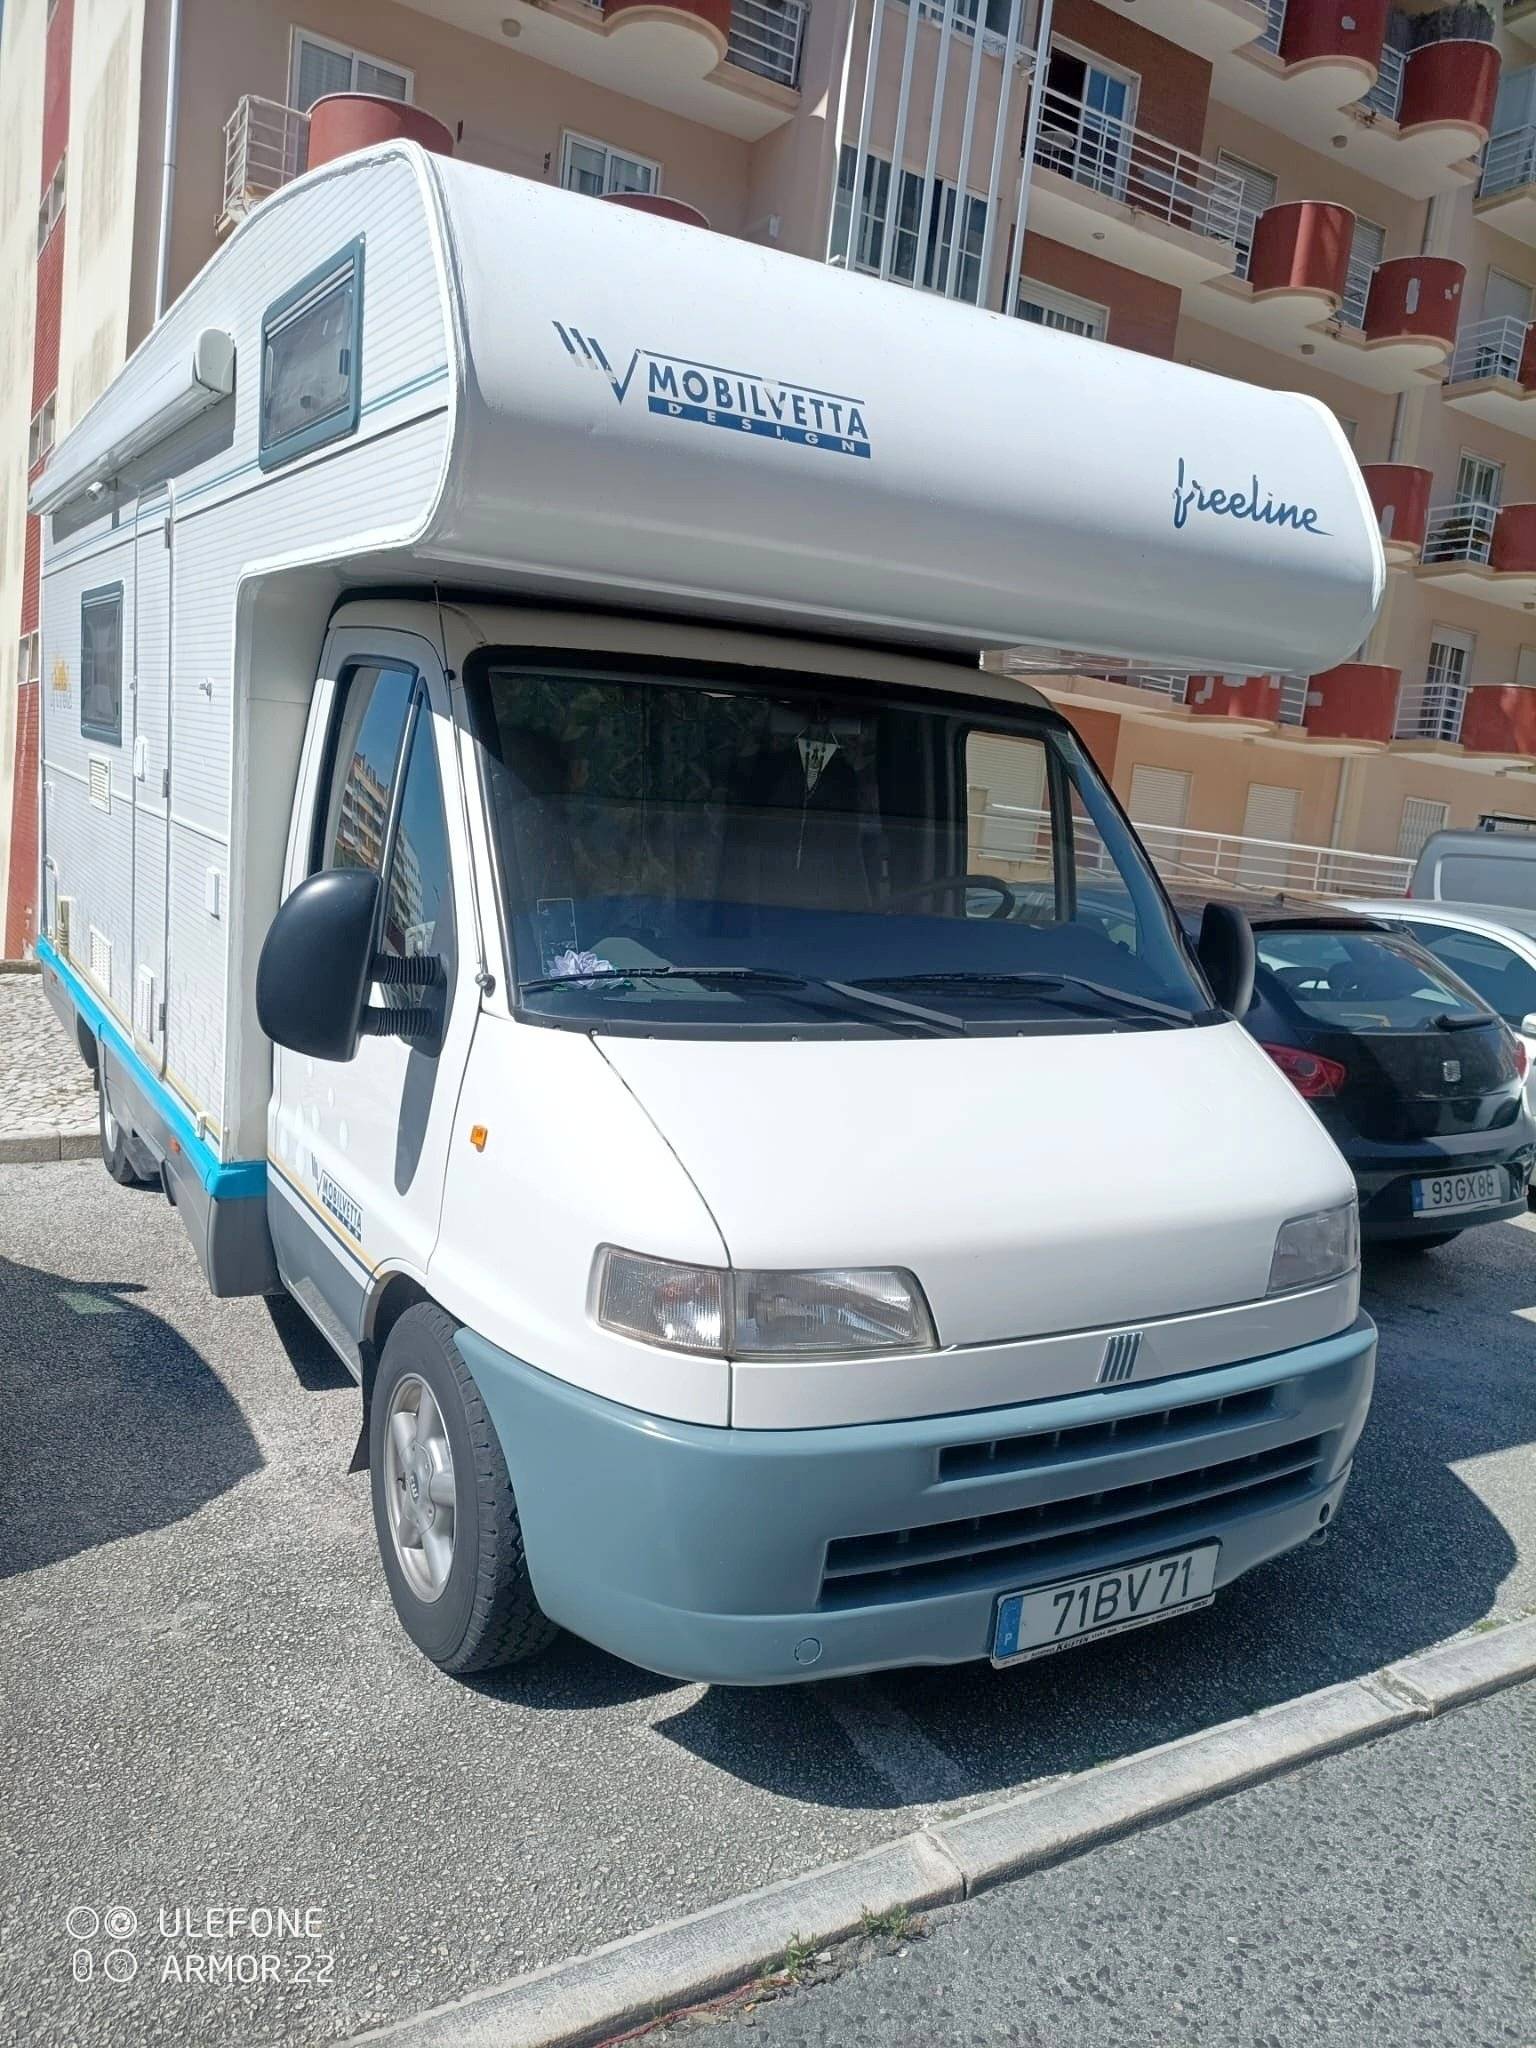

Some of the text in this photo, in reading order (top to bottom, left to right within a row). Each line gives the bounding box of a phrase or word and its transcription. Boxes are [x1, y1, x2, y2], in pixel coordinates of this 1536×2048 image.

[649, 361, 869, 439] MOBILVETTA
[667, 403, 856, 453] DESIGN
[1172, 457, 1335, 537] freeline
[322, 1175, 362, 1234] MOBILVETTA
[1003, 1632, 1013, 1647] P
